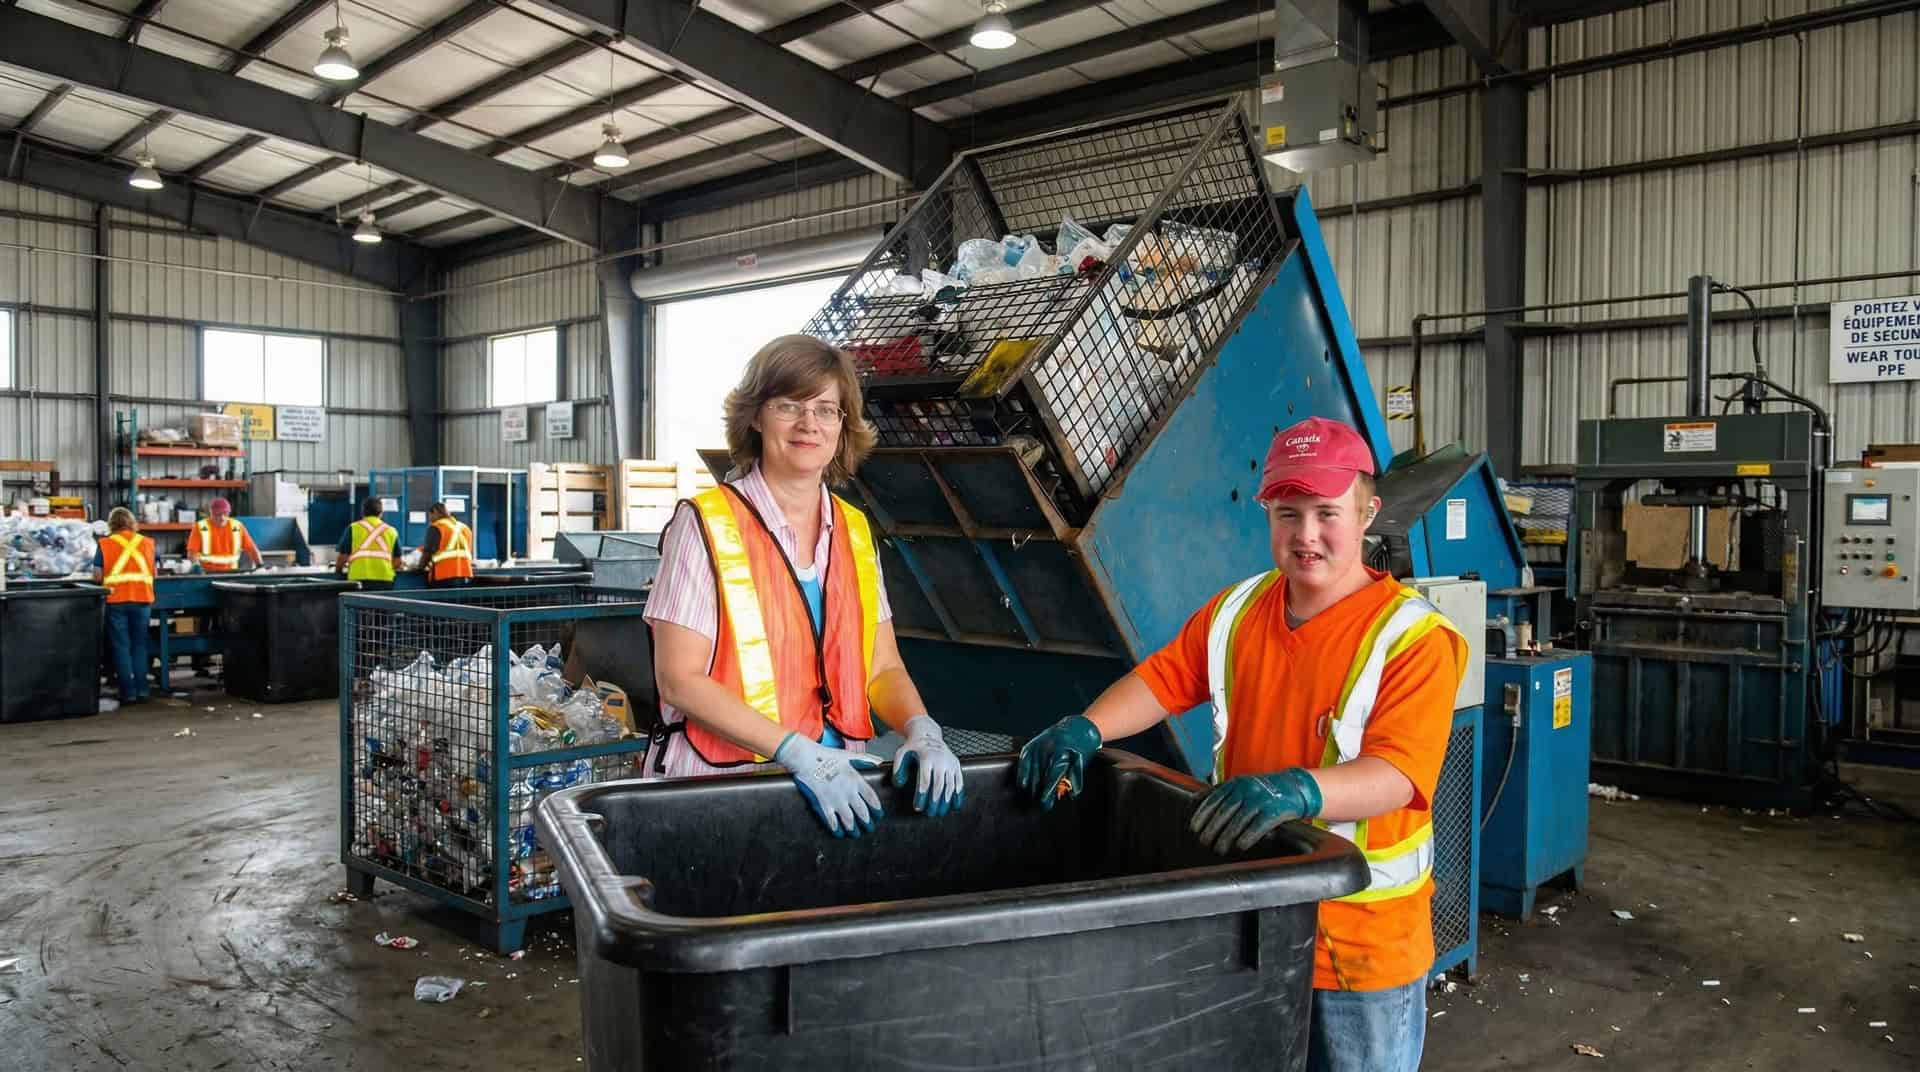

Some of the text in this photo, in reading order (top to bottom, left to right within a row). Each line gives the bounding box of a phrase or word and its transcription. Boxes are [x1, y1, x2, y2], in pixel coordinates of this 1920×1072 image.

[1854, 301, 1908, 316] PORTEZ
[1851, 332, 1869, 343] DE
[1847, 350, 1888, 363] WEAR
[1878, 363, 1905, 377] PPE
